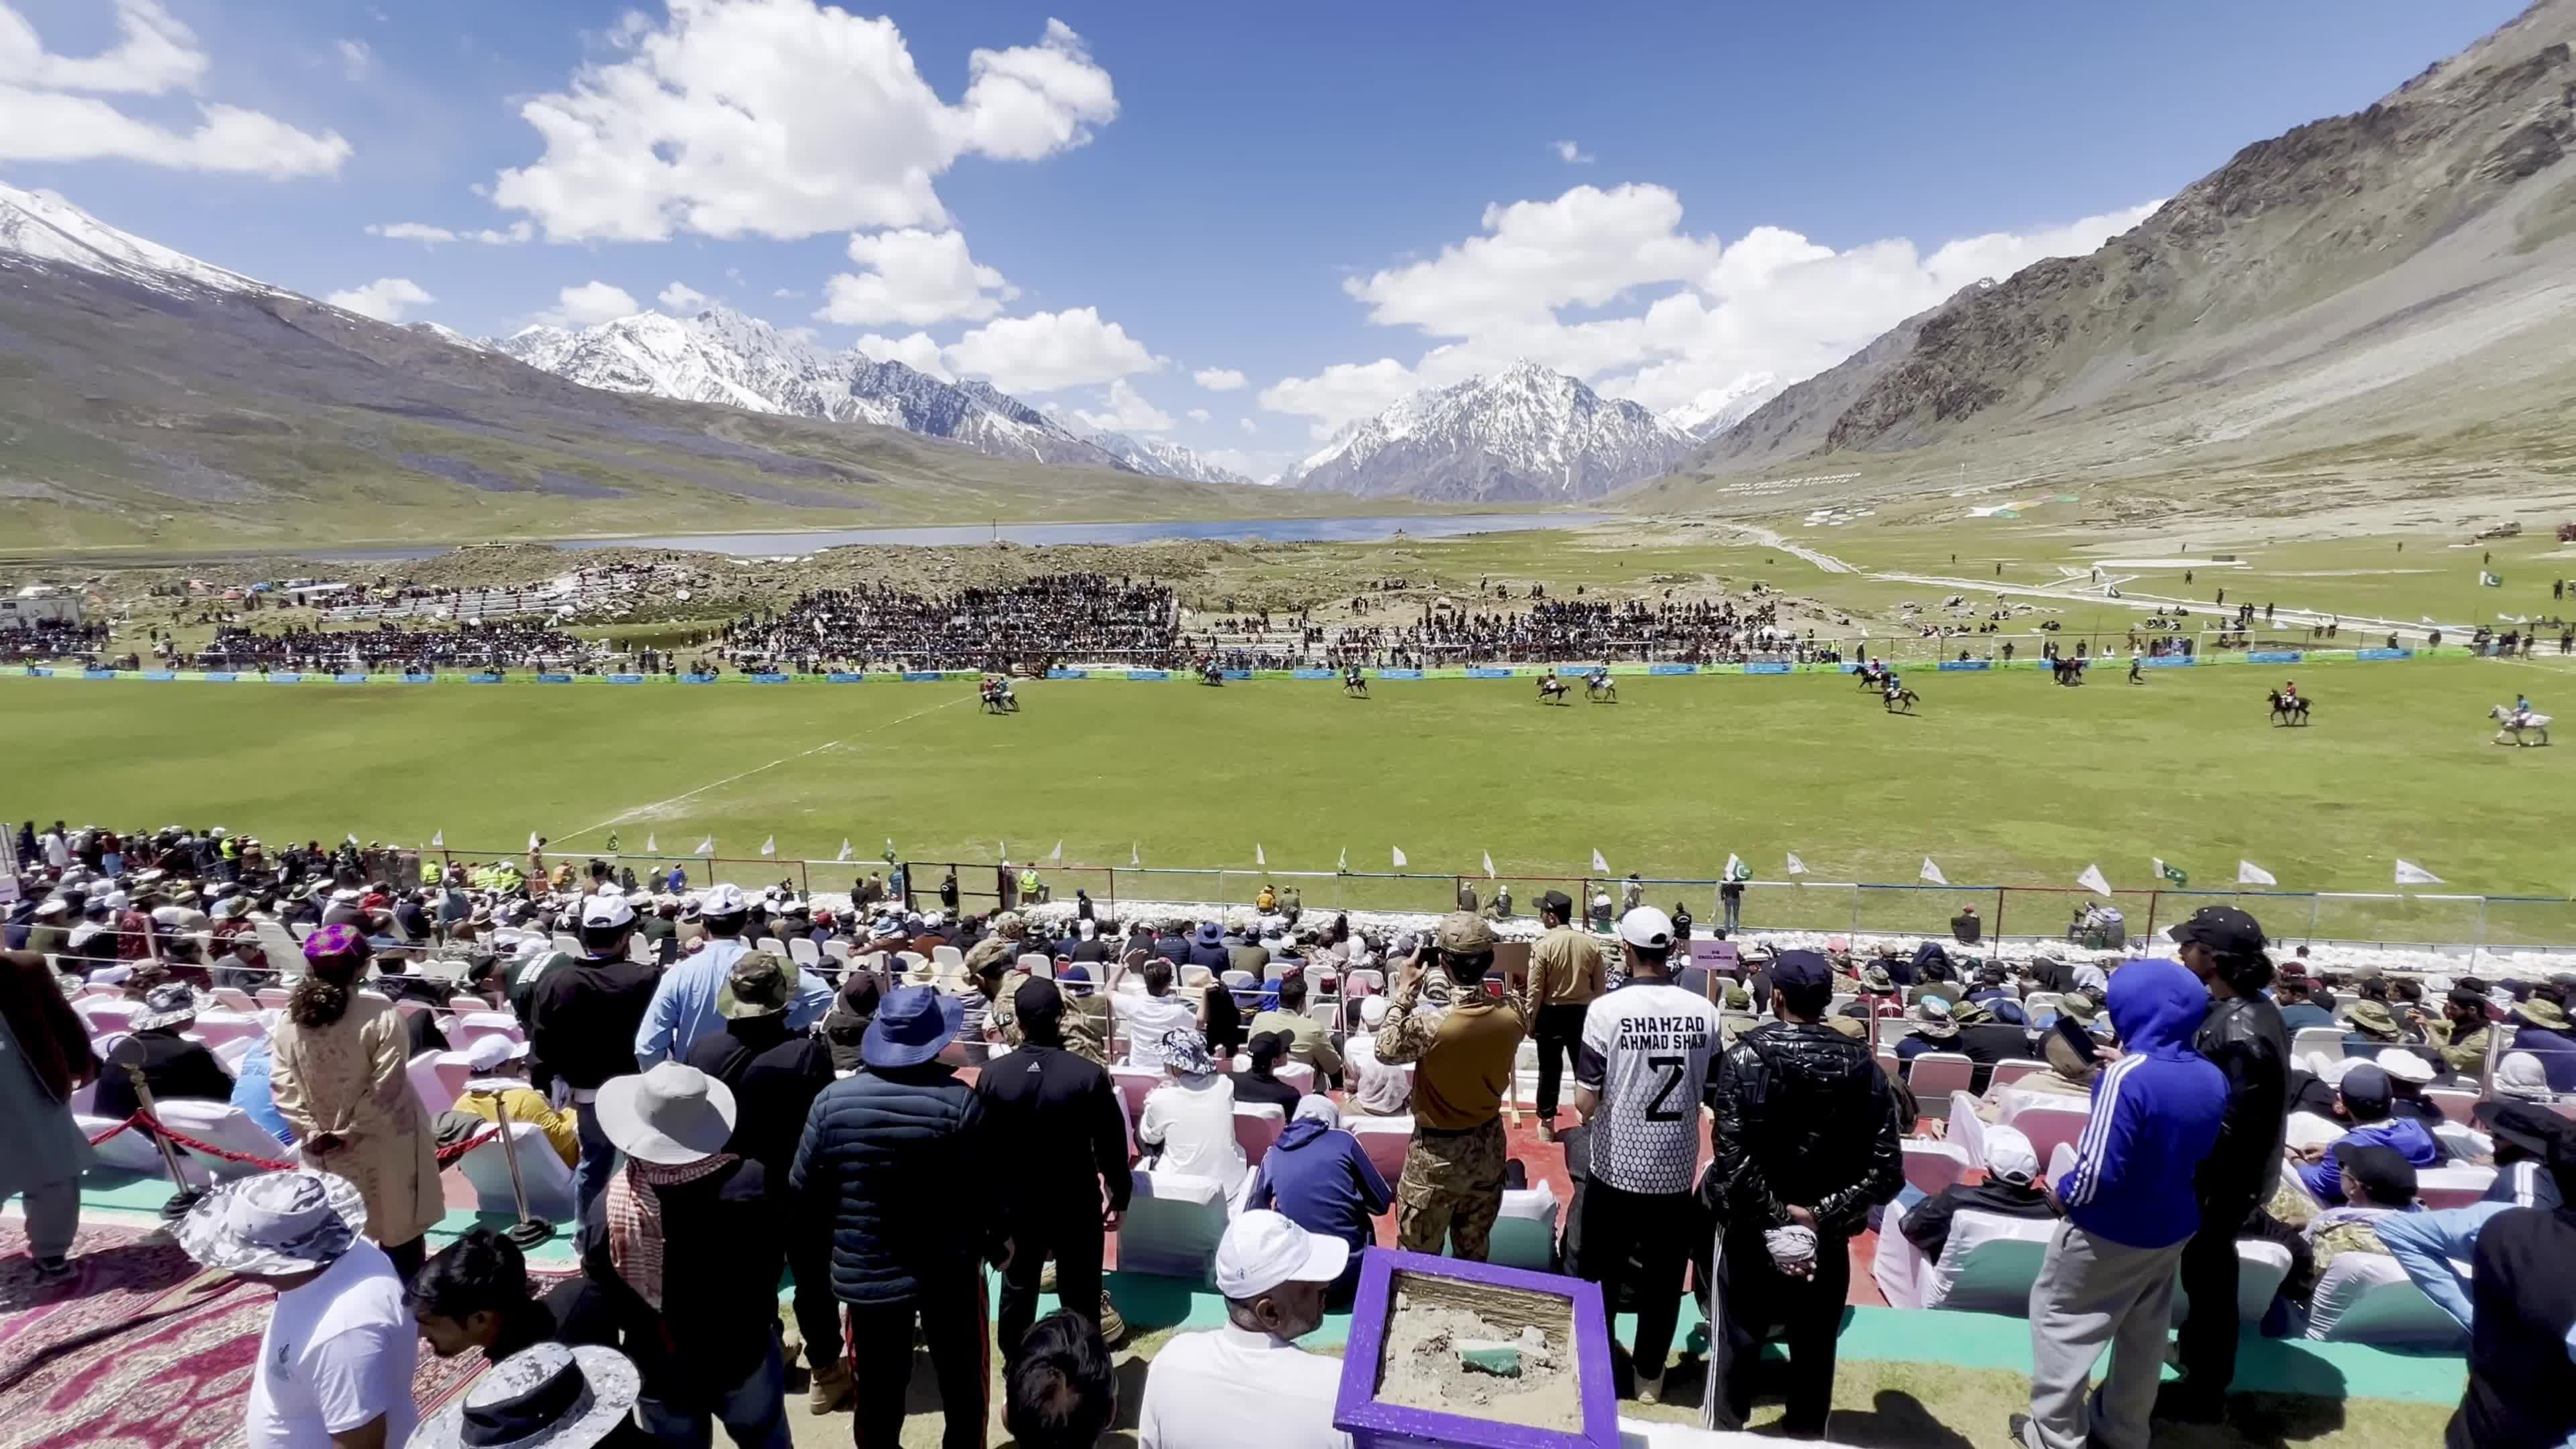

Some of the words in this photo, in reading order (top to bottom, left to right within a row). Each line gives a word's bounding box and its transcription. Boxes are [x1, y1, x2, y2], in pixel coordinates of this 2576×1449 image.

[1621, 1016, 1705, 1033] SHAHZAD
[1620, 1034, 1669, 1051] AHMAD
[1646, 1057, 1685, 1122] 2
